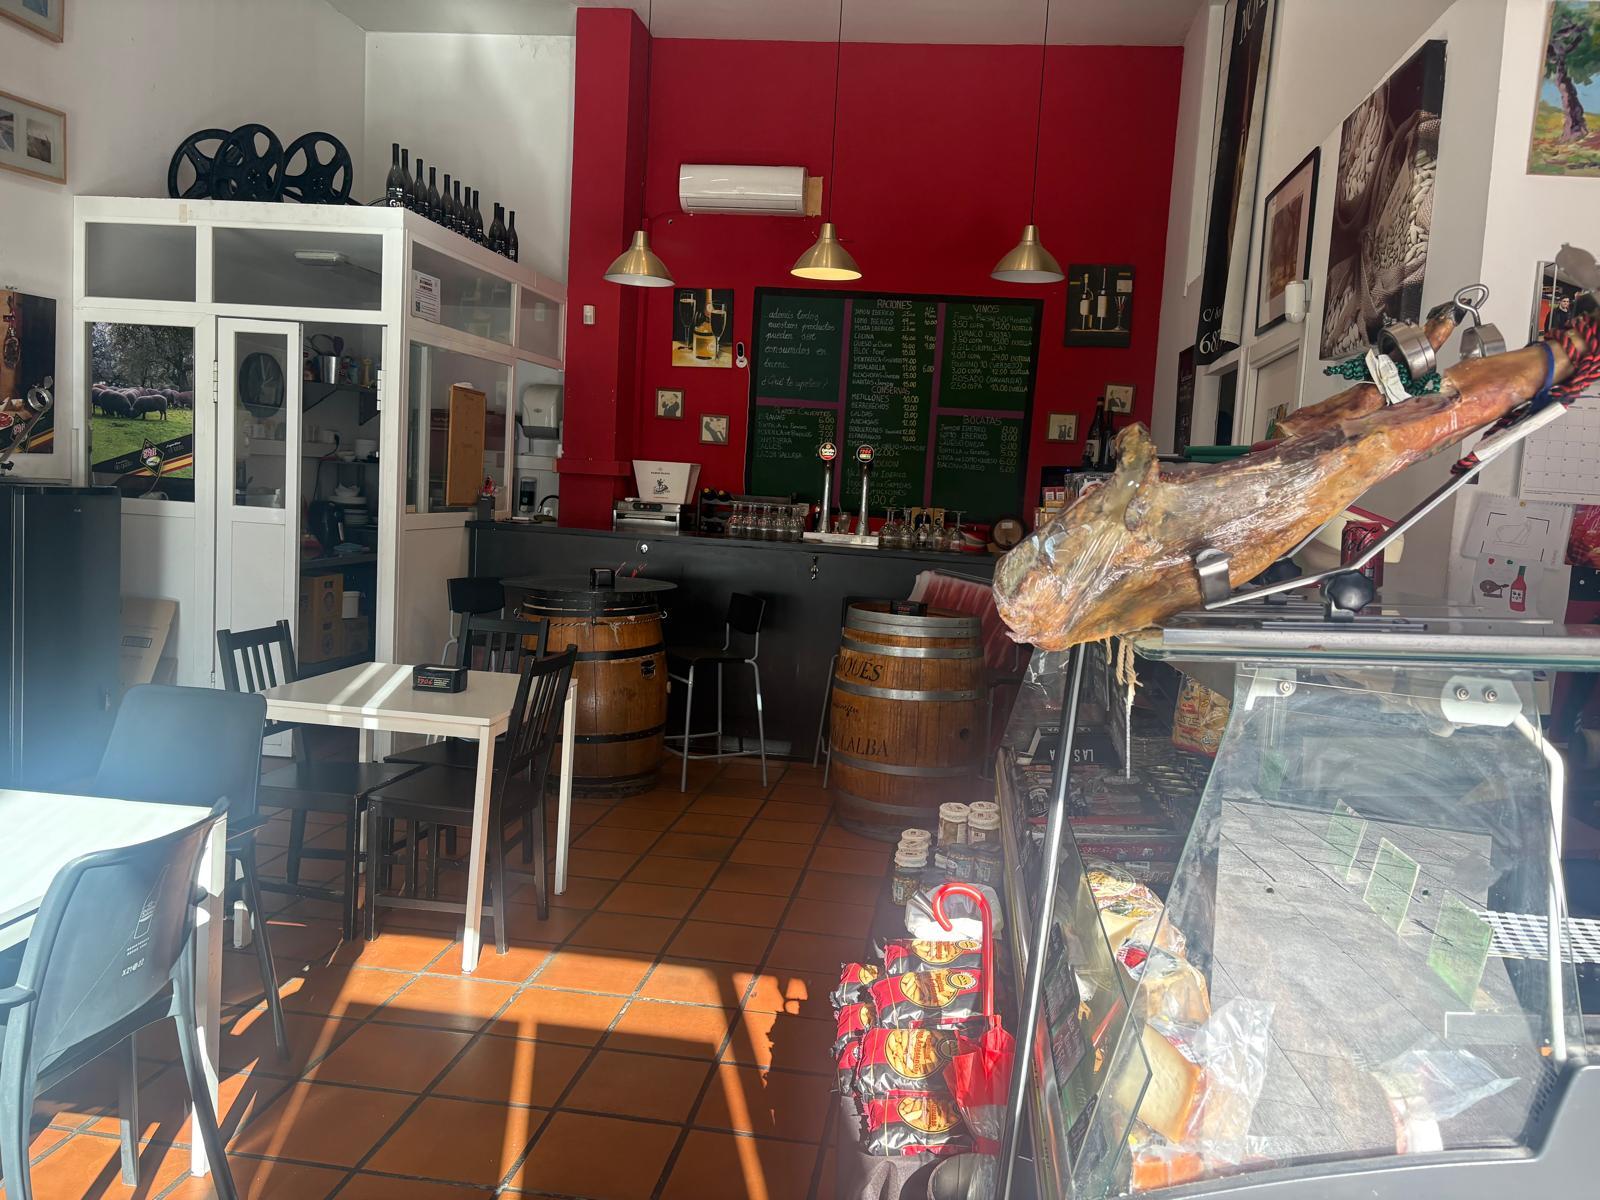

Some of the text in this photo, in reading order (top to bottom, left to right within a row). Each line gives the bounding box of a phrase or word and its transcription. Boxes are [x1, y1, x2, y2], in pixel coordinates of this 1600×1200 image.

[877, 298, 912, 310] RACIONES
[972, 304, 1000, 313] VINOS
[871, 386, 911, 394] CONSERVAS
[962, 414, 1002, 426] BOCATAS
